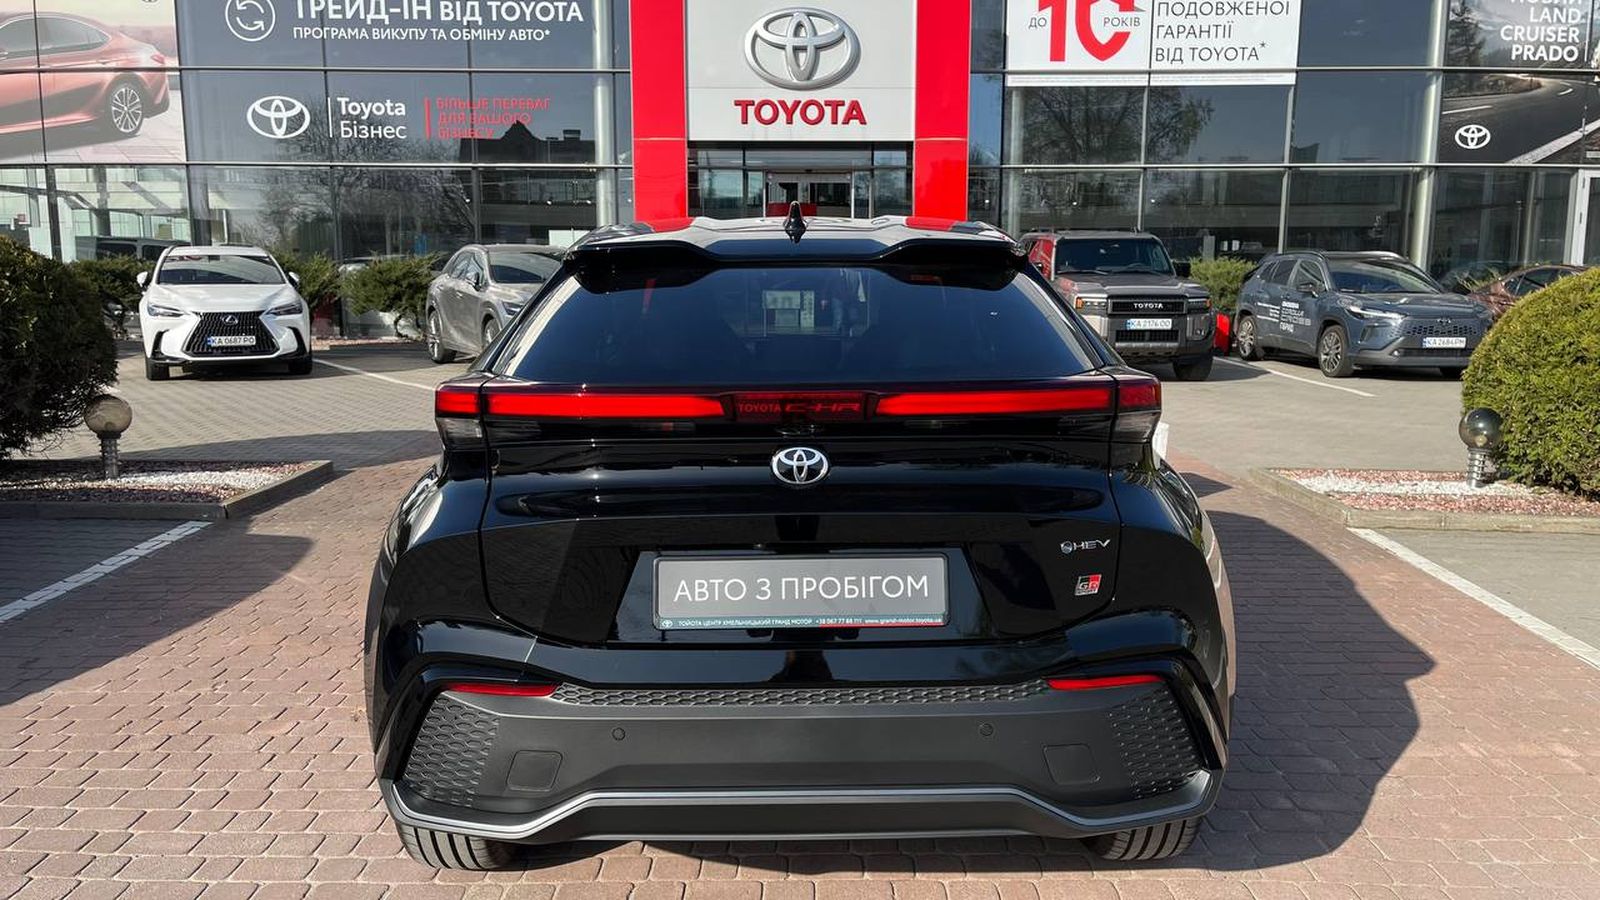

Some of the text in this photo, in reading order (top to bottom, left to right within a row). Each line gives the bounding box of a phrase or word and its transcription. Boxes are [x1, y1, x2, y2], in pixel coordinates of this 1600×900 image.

[439, 1, 482, 25] ВІД
[487, 1, 584, 22] TOYOTA
[1103, 17, 1141, 27] РОКІВ
[1529, 7, 1582, 24] LAND
[1028, 17, 1047, 29] ДО
[1155, 20, 1234, 40] ГАРАНТІЇ
[293, 27, 369, 40] ПРОГРАМА
[372, 28, 428, 40] ВИКУПУ
[430, 28, 447, 40] ТА
[450, 28, 506, 41] ОБМІНУ
[1500, 25, 1580, 43] CRUISER
[1154, 46, 1185, 65] ВІД
[1511, 44, 1579, 62] PRADO
[336, 97, 406, 121] Toyota
[734, 99, 868, 126] TOYOTA
[340, 121, 407, 140] Бізнес
[737, 403, 862, 413] TOYOTA C-HR
[672, 575, 929, 602] АВТО З ПРОБІГОМ
